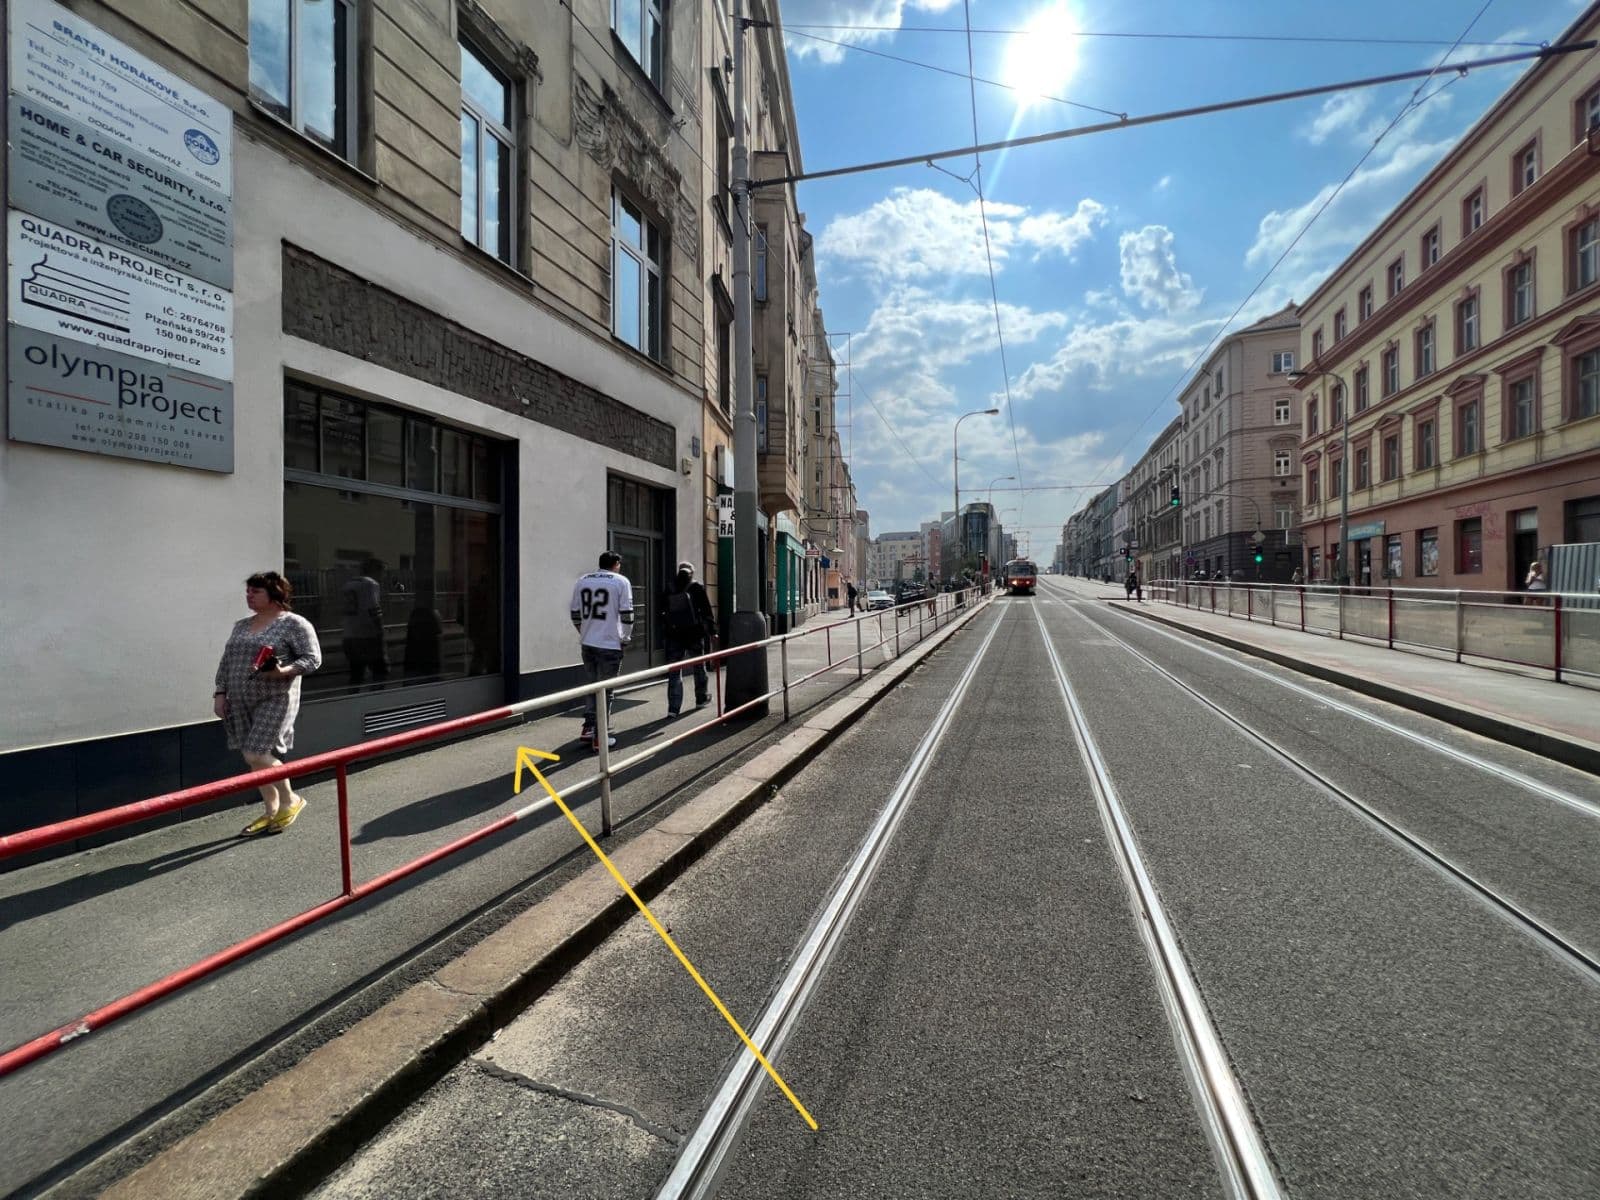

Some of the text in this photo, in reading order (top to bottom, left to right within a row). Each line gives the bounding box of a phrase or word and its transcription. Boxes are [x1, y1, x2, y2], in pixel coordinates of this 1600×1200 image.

[19, 104, 70, 140] HOME
[74, 131, 86, 147] &
[91, 139, 122, 165] CAR
[126, 156, 195, 201] SECURITY,
[199, 194, 226, 215] s.r.o.
[20, 216, 104, 259] QUADRA
[108, 249, 184, 289] PROJECT
[20, 231, 80, 261] Projektová
[82, 255, 88, 263] a
[89, 256, 142, 284] inženýrská
[143, 276, 176, 295] činnost
[177, 290, 188, 299] ve
[27, 282, 87, 310] QUADRA
[57, 316, 201, 368] www.quadraproject.cz
[144, 310, 225, 345] Plzeňská 59/247
[155, 326, 226, 356] 150 00 Praha 5
[24, 343, 163, 393] olympia
[25, 395, 88, 416] statika
[118, 385, 223, 425] project
[720, 497, 733, 508] NA
[720, 519, 734, 536] ŘA
[581, 587, 609, 621] 82
